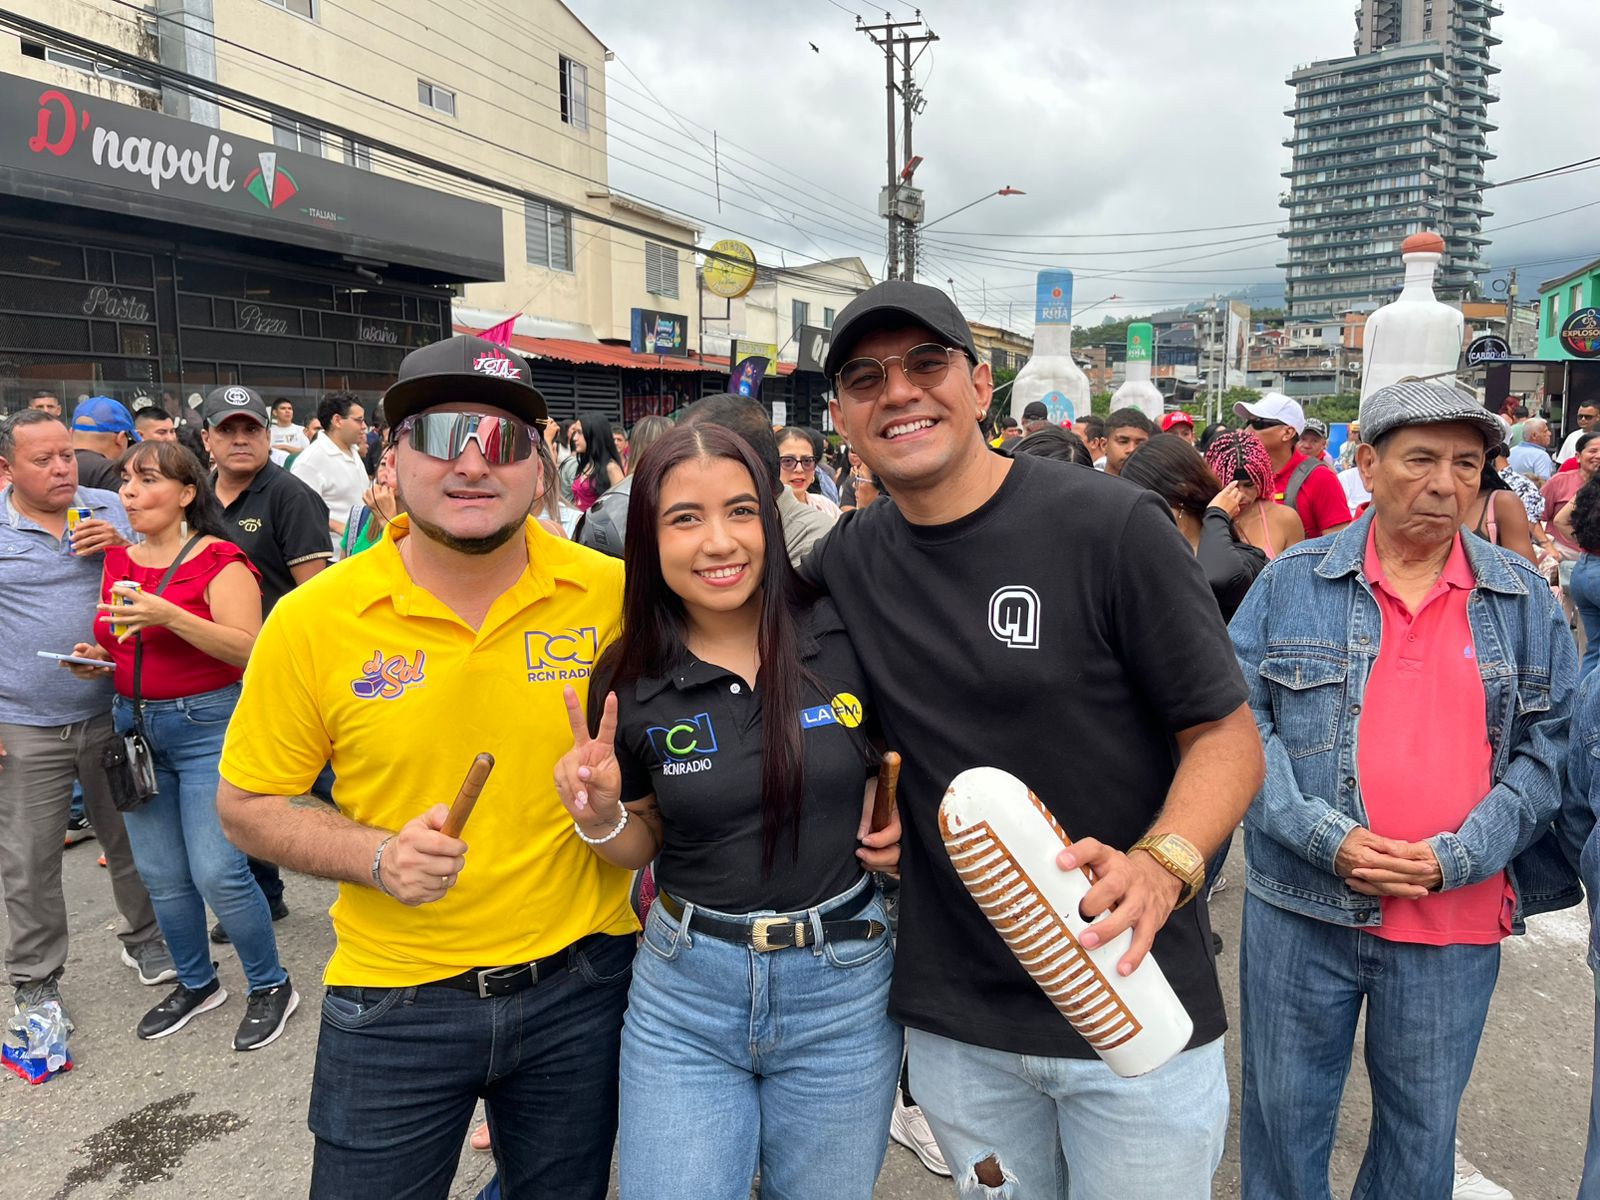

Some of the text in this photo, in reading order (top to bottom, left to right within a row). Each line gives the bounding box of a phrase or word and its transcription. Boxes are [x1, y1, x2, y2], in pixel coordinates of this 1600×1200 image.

[309, 207, 336, 221] ITALIAN
[83, 286, 149, 321] Pasta
[240, 305, 288, 336] Pizza
[380, 649, 425, 699] Sol
[527, 668, 591, 682] RCN RADI
[804, 708, 831, 723] LA
